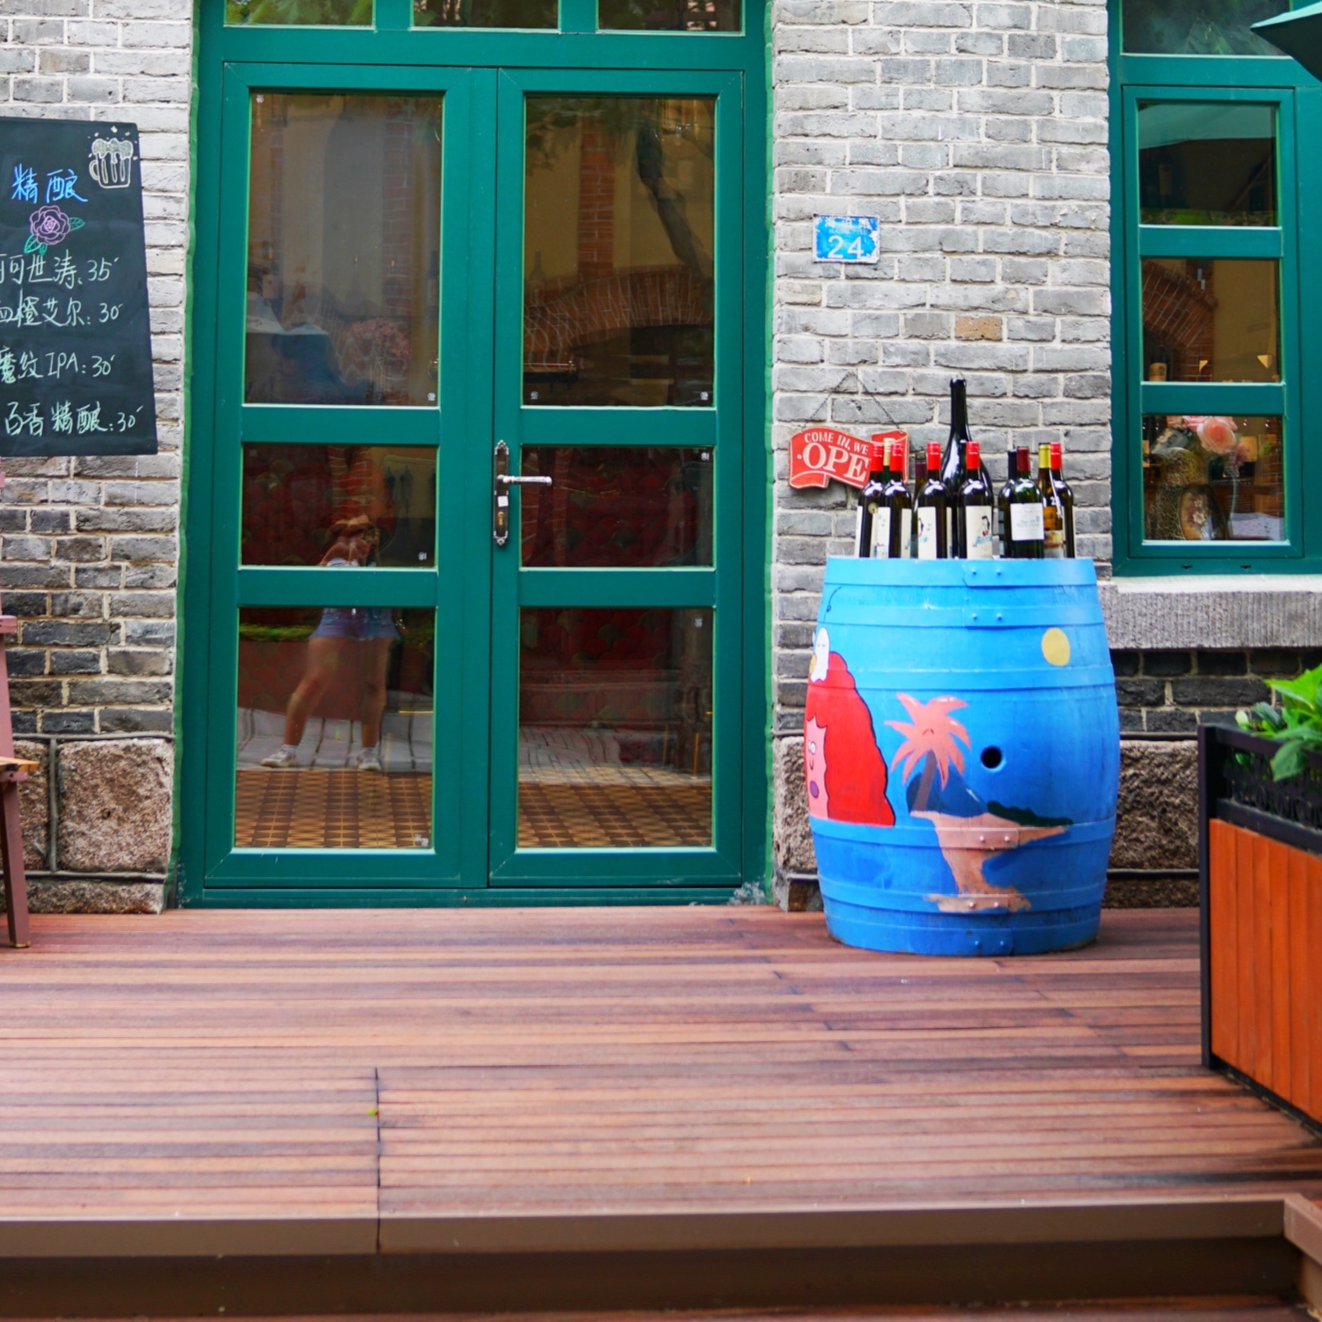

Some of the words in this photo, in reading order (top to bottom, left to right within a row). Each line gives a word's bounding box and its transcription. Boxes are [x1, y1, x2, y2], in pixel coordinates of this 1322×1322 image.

[11, 163, 88, 205] 精酿
[827, 234, 865, 259] 24
[804, 431, 835, 443] COME
[853, 442, 869, 455] WE
[802, 442, 871, 482] OPE
